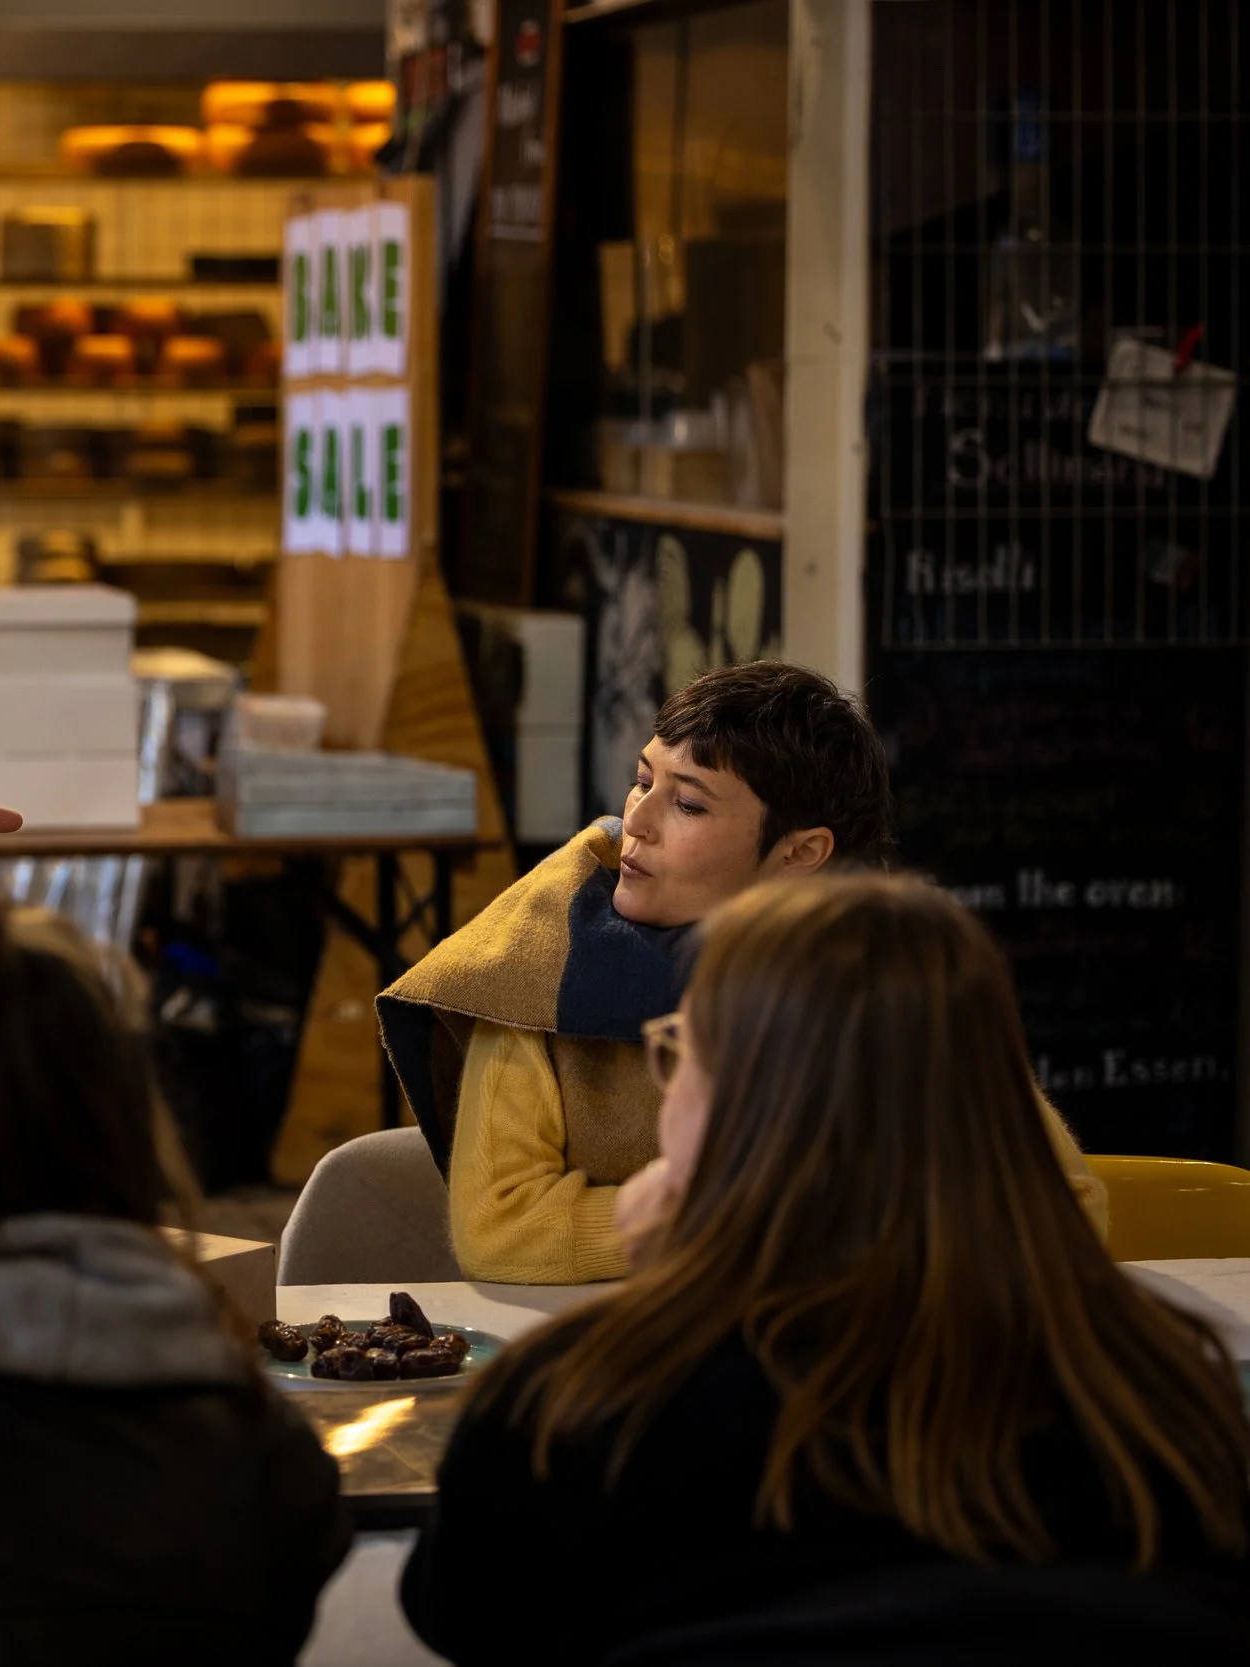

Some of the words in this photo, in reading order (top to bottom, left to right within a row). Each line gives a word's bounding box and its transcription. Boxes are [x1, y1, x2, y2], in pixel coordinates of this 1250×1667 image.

[291, 242, 404, 343] BAKE
[291, 425, 405, 522] SALE
[1016, 867, 1076, 909] the
